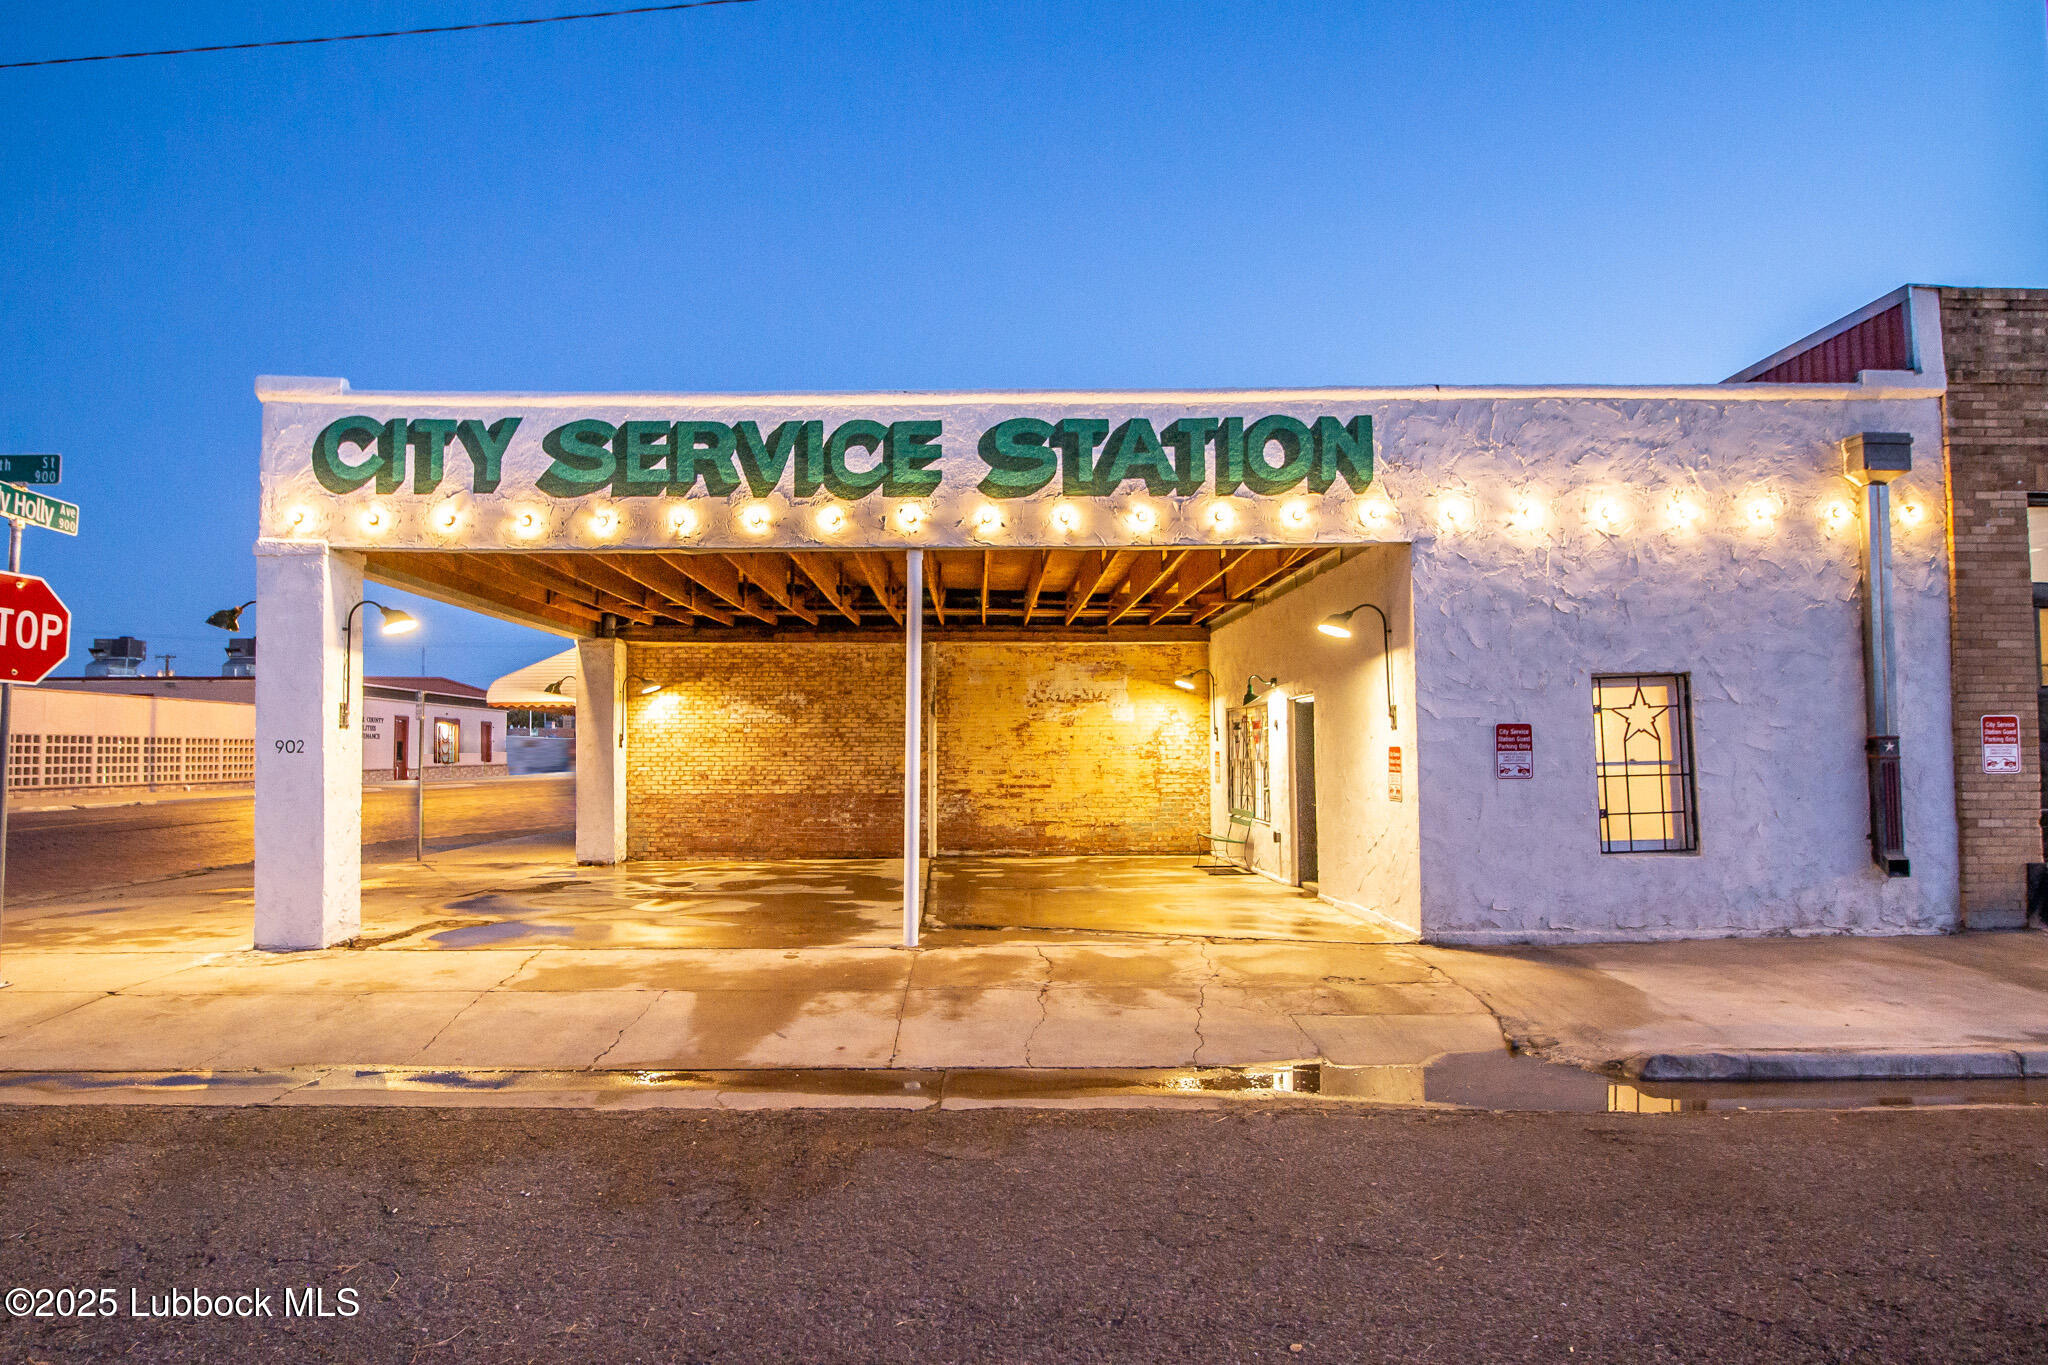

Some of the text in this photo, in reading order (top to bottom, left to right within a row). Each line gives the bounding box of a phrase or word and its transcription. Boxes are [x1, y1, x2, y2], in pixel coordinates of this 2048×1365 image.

[42, 457, 55, 469] St
[312, 414, 1374, 500] CITY SERVICE STATION
[35, 470, 56, 482] 900
[14, 492, 55, 528] Holly
[60, 504, 76, 519] Ave
[58, 517, 76, 532] 900
[0, 607, 63, 651] TOP
[275, 739, 305, 754] 902
